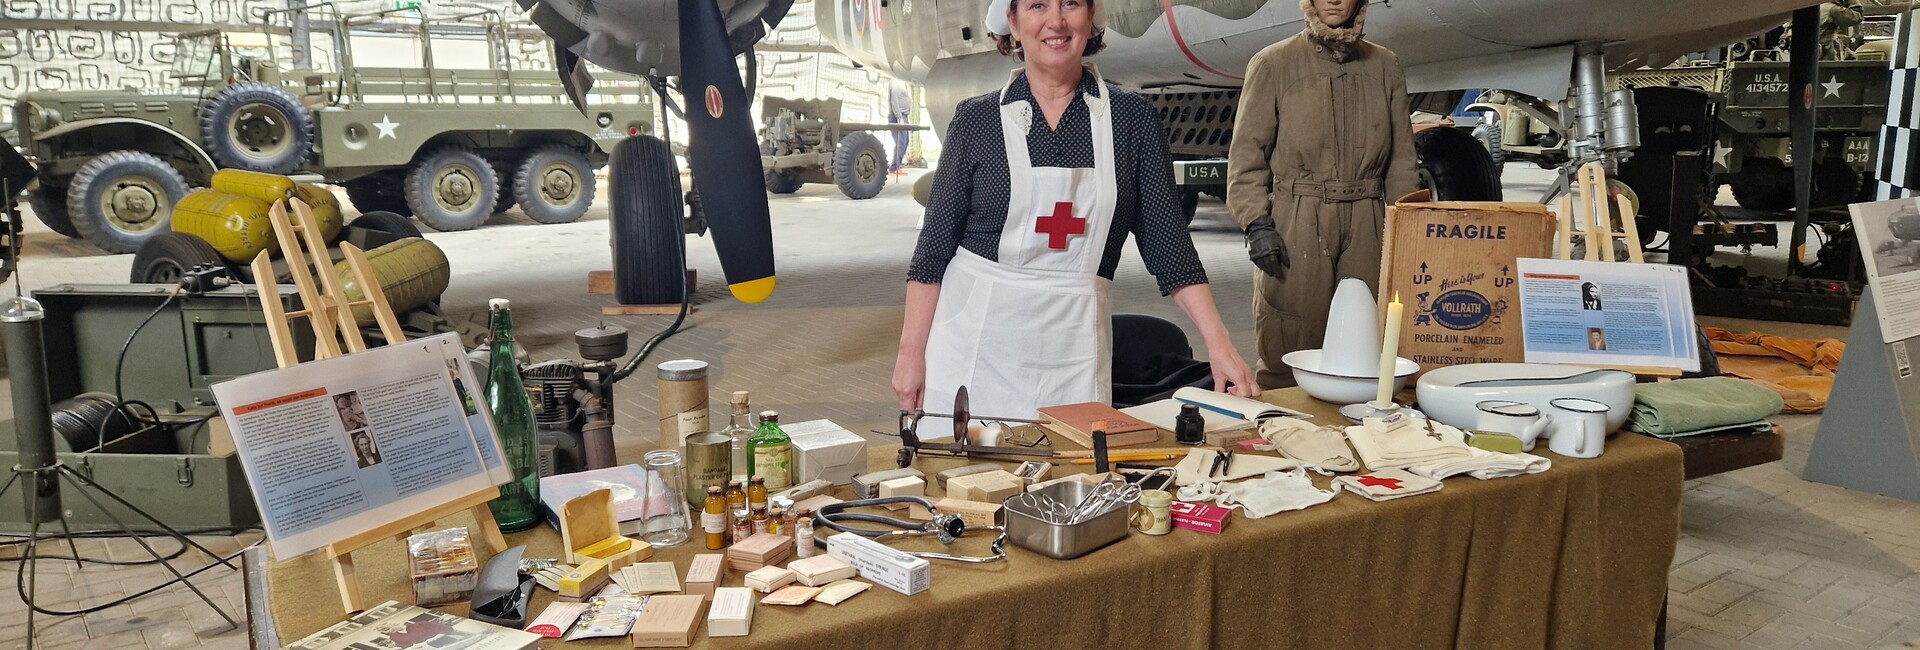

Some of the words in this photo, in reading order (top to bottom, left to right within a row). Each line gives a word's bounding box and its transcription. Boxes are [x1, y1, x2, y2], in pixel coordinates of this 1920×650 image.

[1755, 74, 1782, 83] U.S.A.
[1745, 83, 1789, 93] 4134572
[1189, 166, 1219, 178] USA
[1425, 223, 1507, 240] FRAGILE
[1413, 275, 1432, 285] UP
[1494, 277, 1514, 288] UP
[1441, 302, 1482, 314] VOLLRATH
[1414, 334, 1459, 344] PORCELAIN
[1463, 335, 1504, 345] ENAMELED
[1413, 354, 1453, 365] STAINLESS
